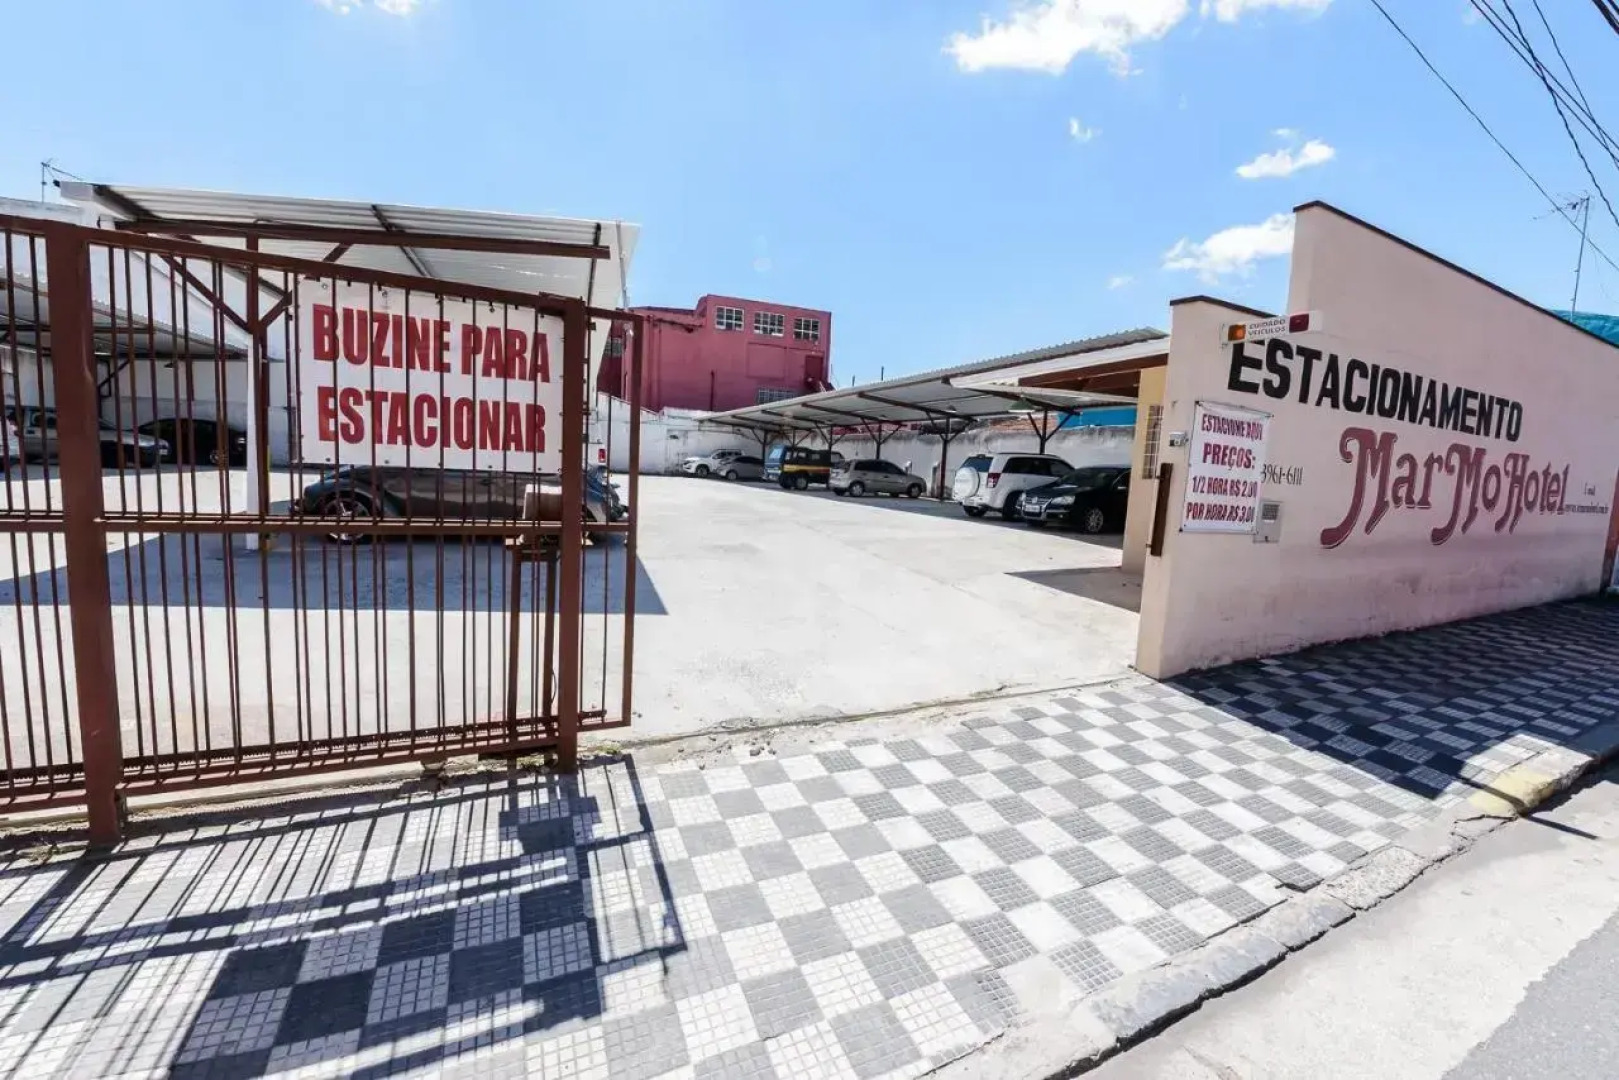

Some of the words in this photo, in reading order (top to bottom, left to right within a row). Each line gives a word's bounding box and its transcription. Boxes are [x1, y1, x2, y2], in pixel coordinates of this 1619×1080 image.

[313, 303, 451, 374] BUZINE
[461, 323, 550, 383] PARA
[1228, 338, 1523, 442] ESTACIONAMENTO
[317, 385, 546, 454] ESTACIONAR
[1201, 413, 1245, 437] ESTACIONE
[1245, 420, 1263, 441] AQUI
[1202, 442, 1256, 471] PREÇOS:
[1192, 475, 1206, 494] 1/2
[1206, 476, 1228, 496] HORA
[1229, 479, 1241, 498] R$
[1186, 501, 1205, 520] POR
[1204, 503, 1228, 521] HORA
[1227, 505, 1239, 522] R$
